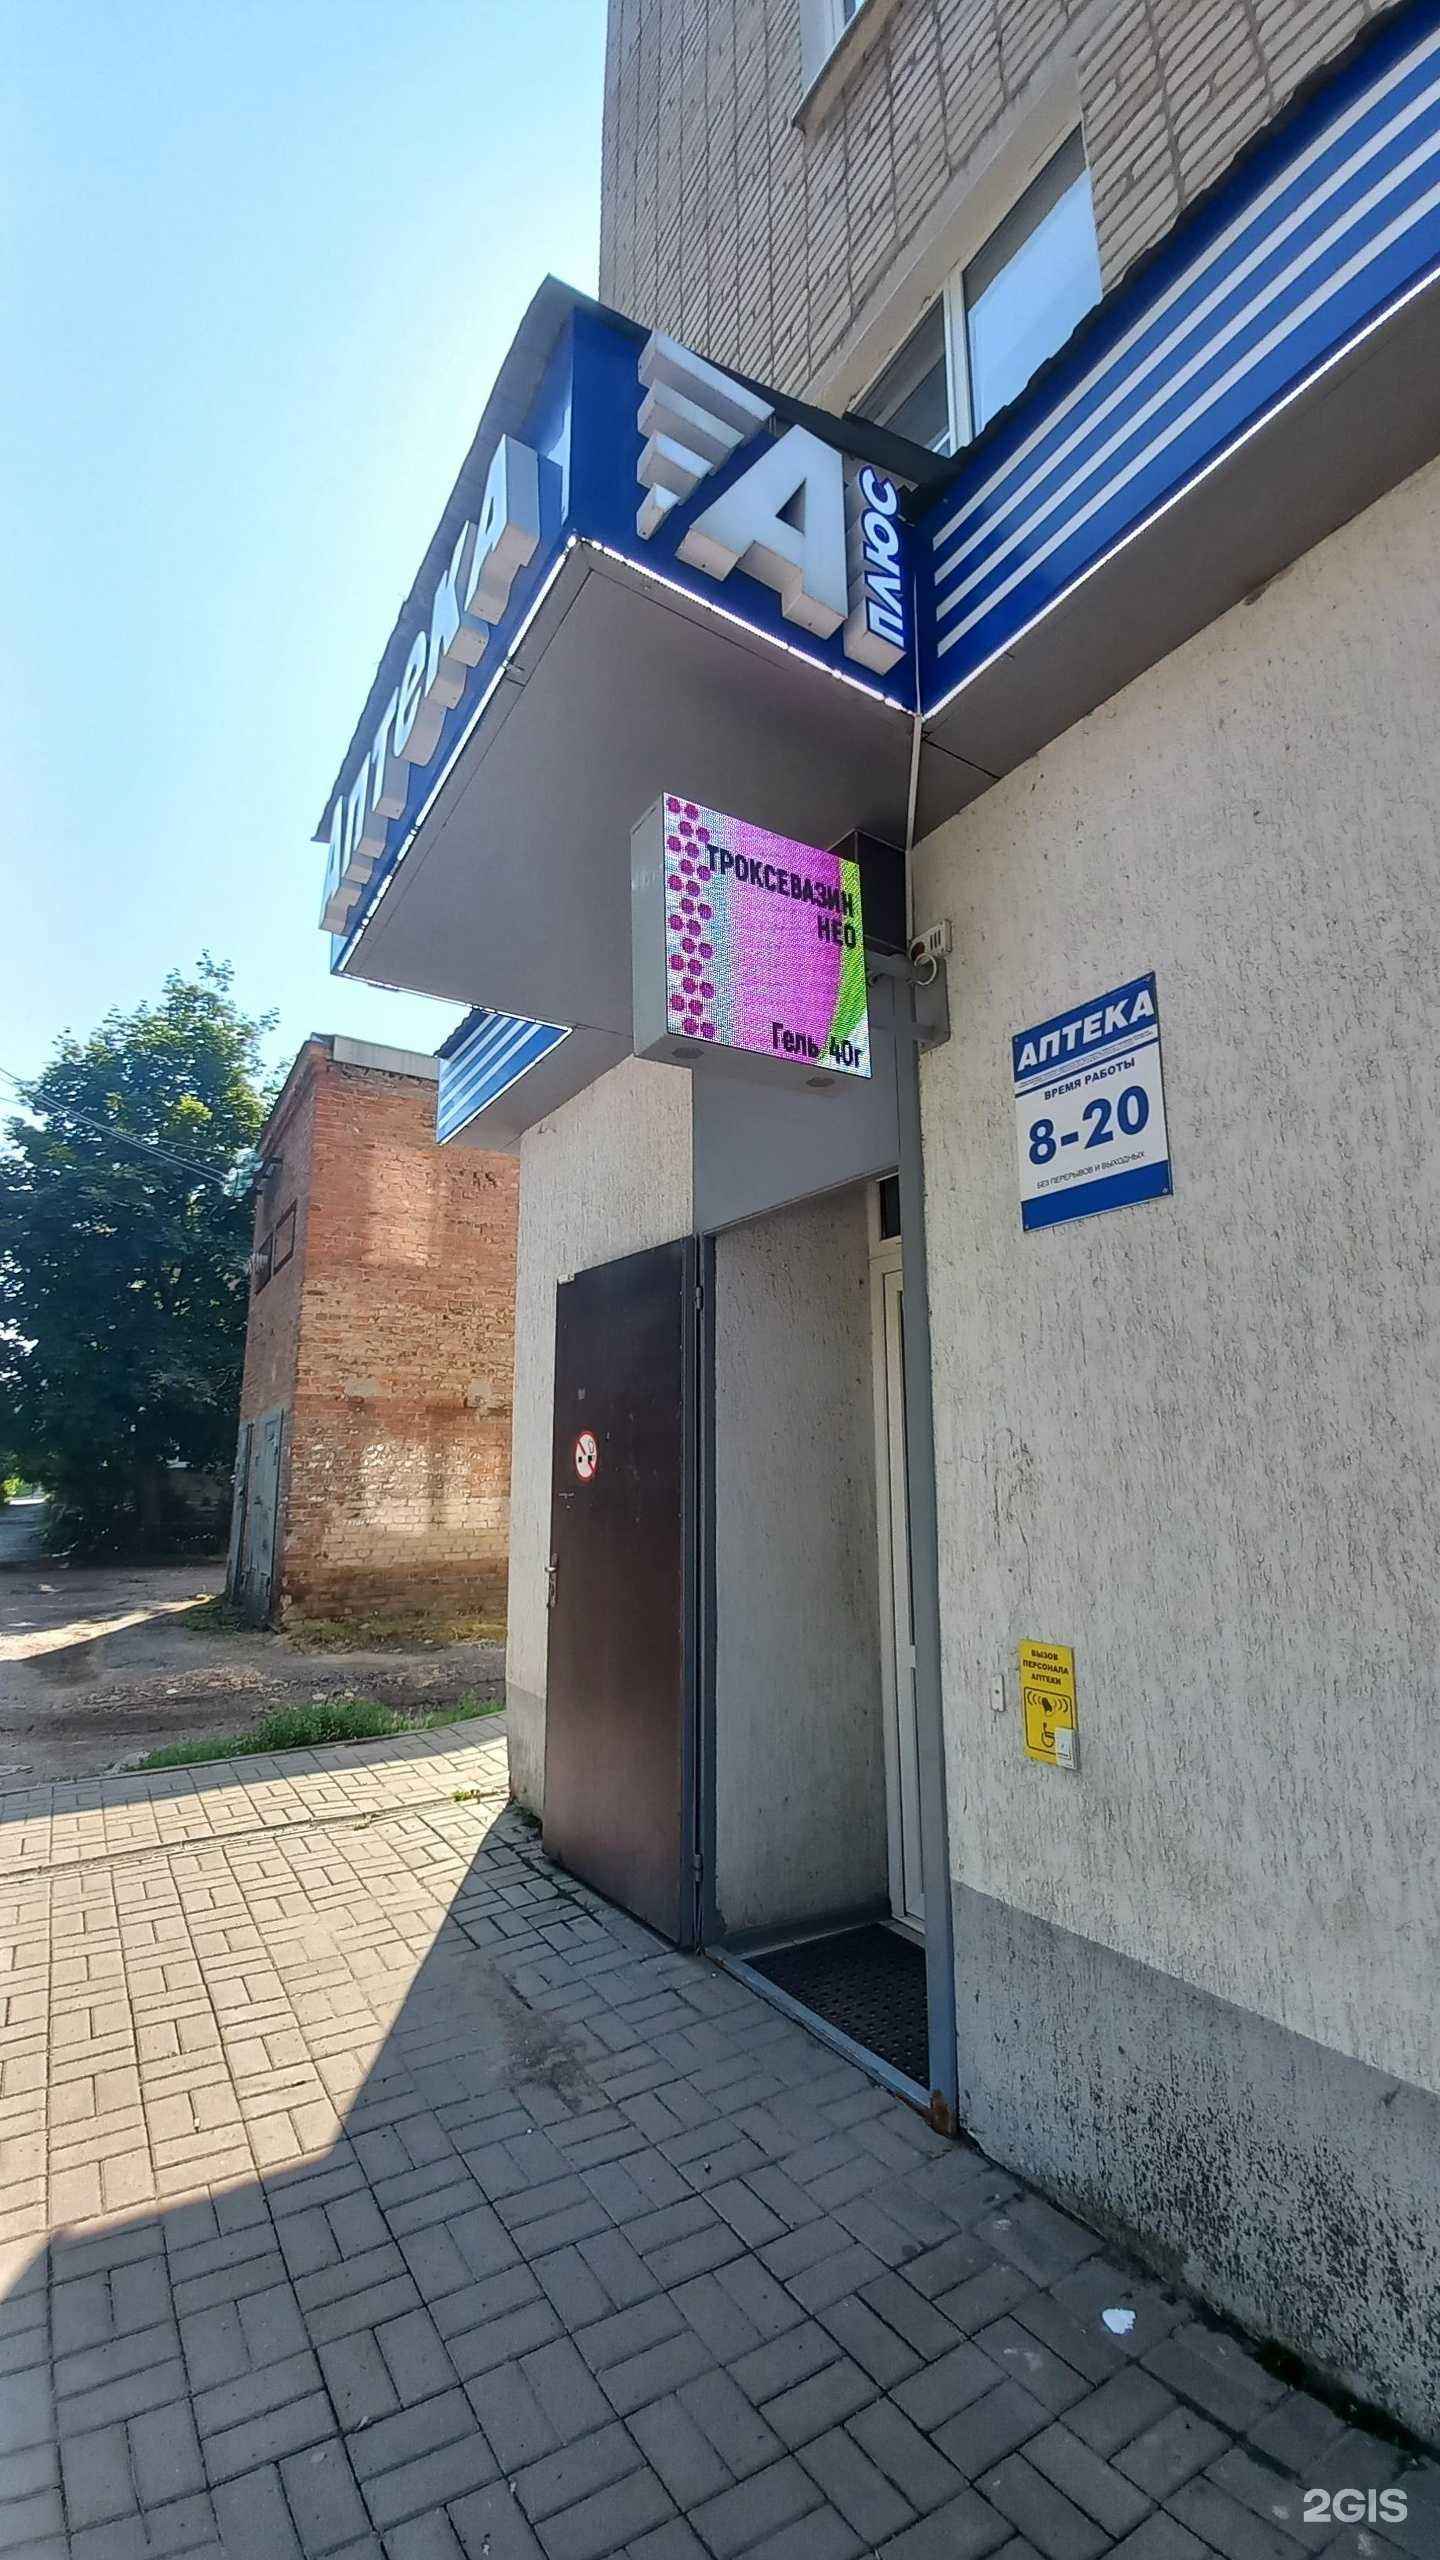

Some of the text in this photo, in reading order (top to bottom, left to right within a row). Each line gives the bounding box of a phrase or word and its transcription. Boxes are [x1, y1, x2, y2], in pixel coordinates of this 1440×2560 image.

[860, 466, 904, 647] ПЛЮС
[706, 843, 854, 918] ТРОКСЕВАЗИН
[817, 915, 856, 948] НЕО
[772, 1021, 861, 1069] Гель 40г
[1017, 990, 1155, 1072] АПТЕКА
[1044, 1078, 1081, 1101] ВРЕМЯ
[1084, 1057, 1135, 1085] РАБОТЫ
[1028, 1085, 1150, 1165] 8-20
[1036, 1150, 1145, 1189] БЕЗ ПЕРЕРЫВОВ И ВЫХОДНЫХ
[1022, 1659, 1070, 1675] ПЕРСОНАЛА
[1031, 1649, 1059, 1661] ВЫЗОВ
[1031, 1673, 1061, 1686] АПТЕКИ
